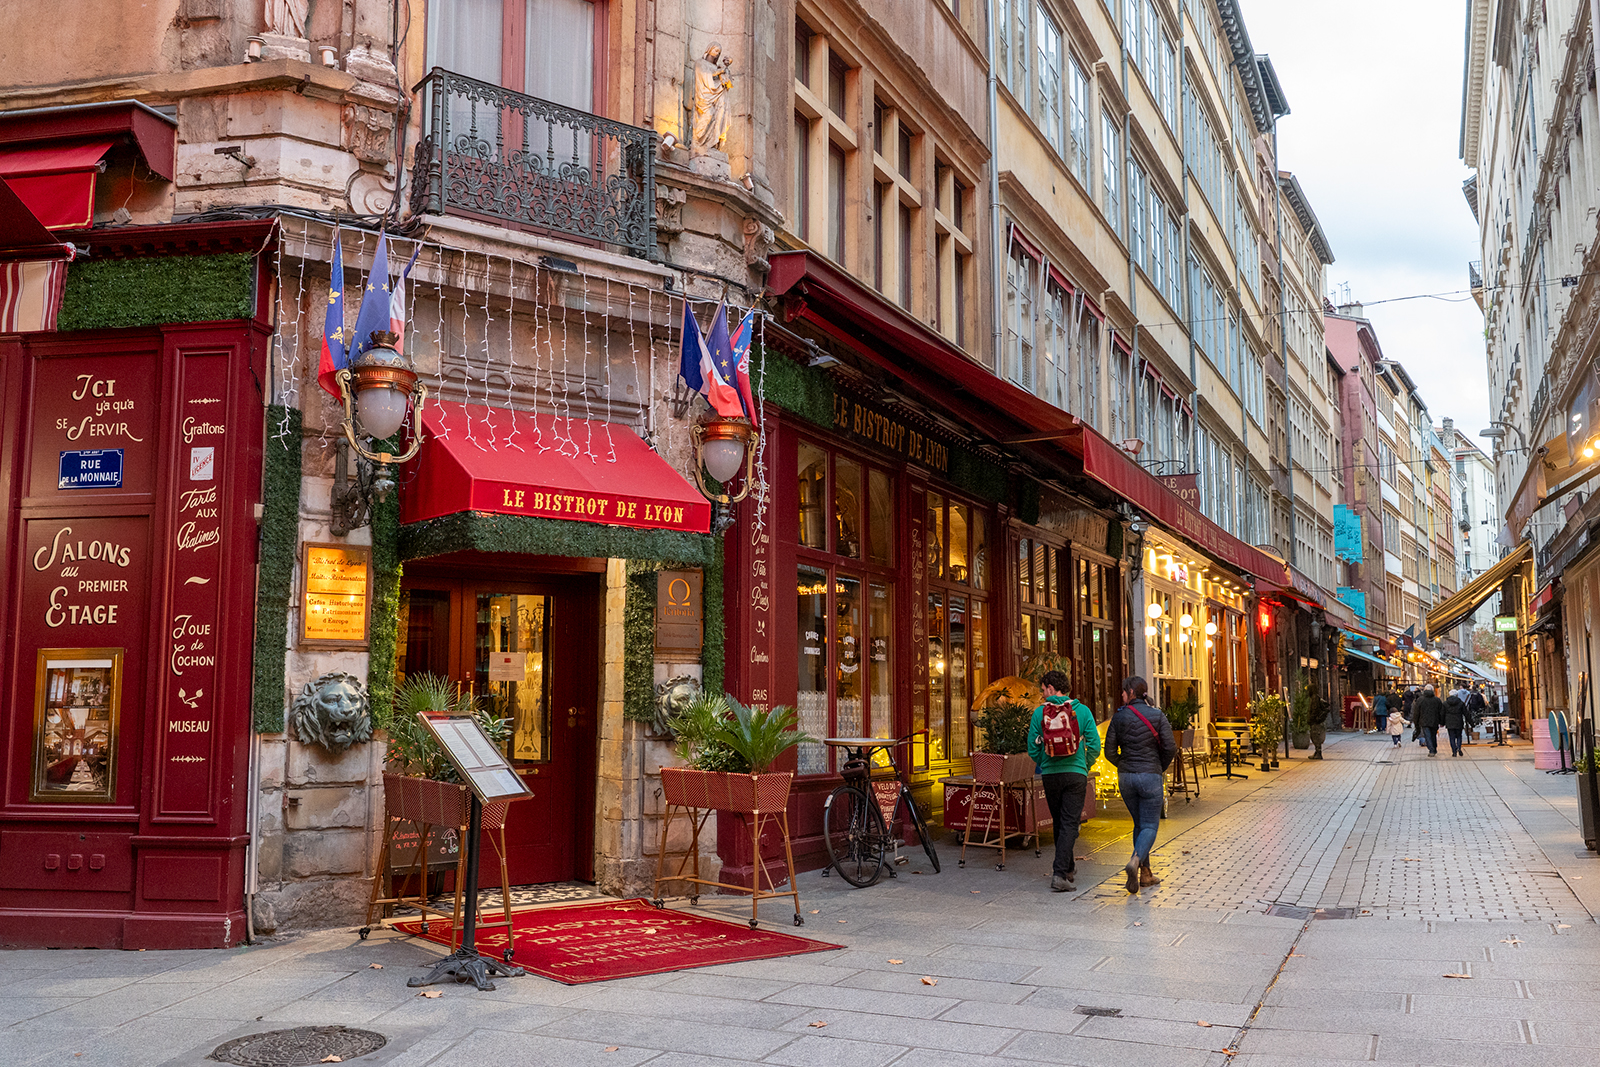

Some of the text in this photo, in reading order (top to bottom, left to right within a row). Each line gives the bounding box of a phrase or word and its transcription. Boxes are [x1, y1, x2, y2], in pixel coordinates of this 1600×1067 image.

[56, 416, 143, 441] SE SERVIR
[182, 417, 225, 444] Grattons
[833, 392, 949, 473] LE BISTROT DE LYON
[80, 459, 101, 470] RUE
[191, 452, 212, 476] LICENCE
[62, 476, 69, 484] DE
[80, 472, 118, 482] MONNAIE
[1164, 478, 1177, 488] LE
[180, 485, 217, 512] Tarte
[503, 489, 684, 524] LE BISTROT DE LYON
[196, 508, 217, 518] AUX
[177, 521, 220, 552] Pralines
[34, 527, 130, 571] SALONS
[61, 563, 78, 577] au
[78, 580, 128, 592] PREMIER
[45, 586, 118, 628] ETAGE
[172, 615, 210, 639] JOUE
[191, 639, 204, 651] de
[171, 644, 215, 676] COCHON
[752, 689, 768, 700] GRAS
[169, 721, 210, 733] MUSEAU
[514, 919, 701, 934] BISTROT
[526, 934, 582, 944] DE
[557, 939, 641, 952] Depuis
[549, 955, 632, 968] ouvert
[632, 948, 681, 957] Rue
